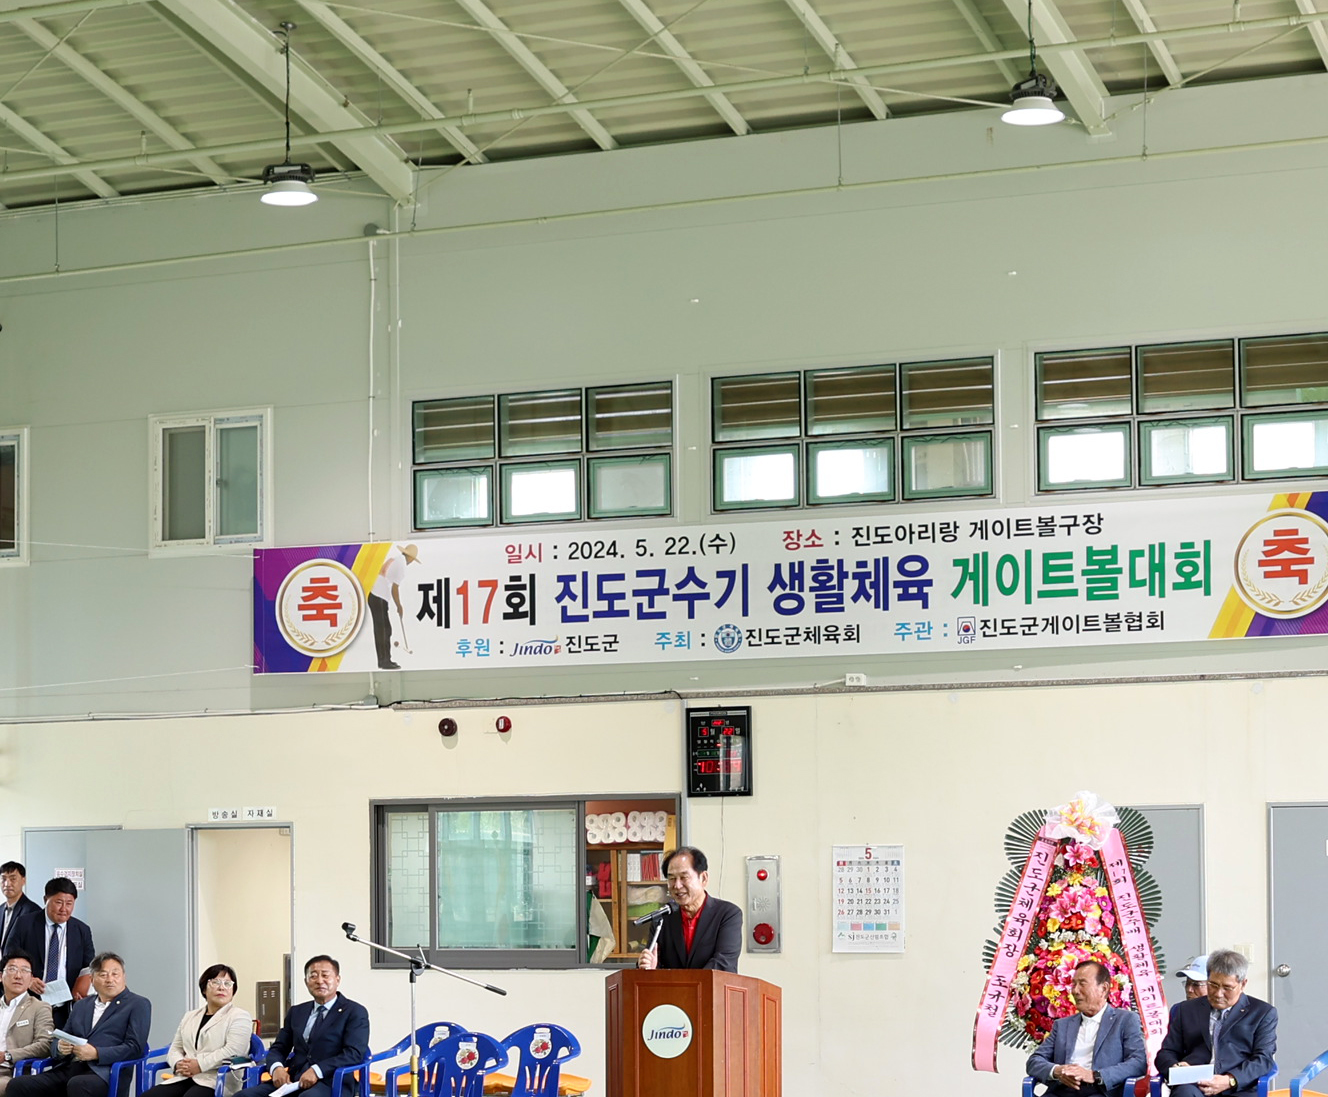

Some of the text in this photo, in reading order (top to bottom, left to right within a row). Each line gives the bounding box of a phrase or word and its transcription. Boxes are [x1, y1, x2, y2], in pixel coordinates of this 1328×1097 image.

[782, 528, 824, 551] 장소
[851, 520, 960, 547] 진도아리랑
[968, 512, 1104, 541] 게이트볼구장
[504, 542, 543, 564] 일시
[568, 540, 625, 560] 2024.
[635, 539, 654, 557] 5.
[664, 532, 736, 556] 22.(수)
[1258, 528, 1315, 585] 축
[416, 539, 1212, 629] 제17회 진도군수기 생활체육 게이트볼대회
[297, 576, 343, 628] 축
[654, 630, 691, 651] 주최
[745, 623, 861, 647] 진도군체육회
[893, 620, 933, 642] 주관
[979, 610, 1165, 638] 진도군게이트볼협회
[957, 635, 976, 645] JGF
[455, 638, 490, 658] 후원
[510, 641, 553, 657] Jindo
[565, 634, 620, 654] 진도군
[211, 808, 273, 820] 방송실 자재실
[864, 847, 872, 860] 5
[1003, 851, 1049, 958] 진도군체육회장
[647, 1029, 682, 1041] Jindo
